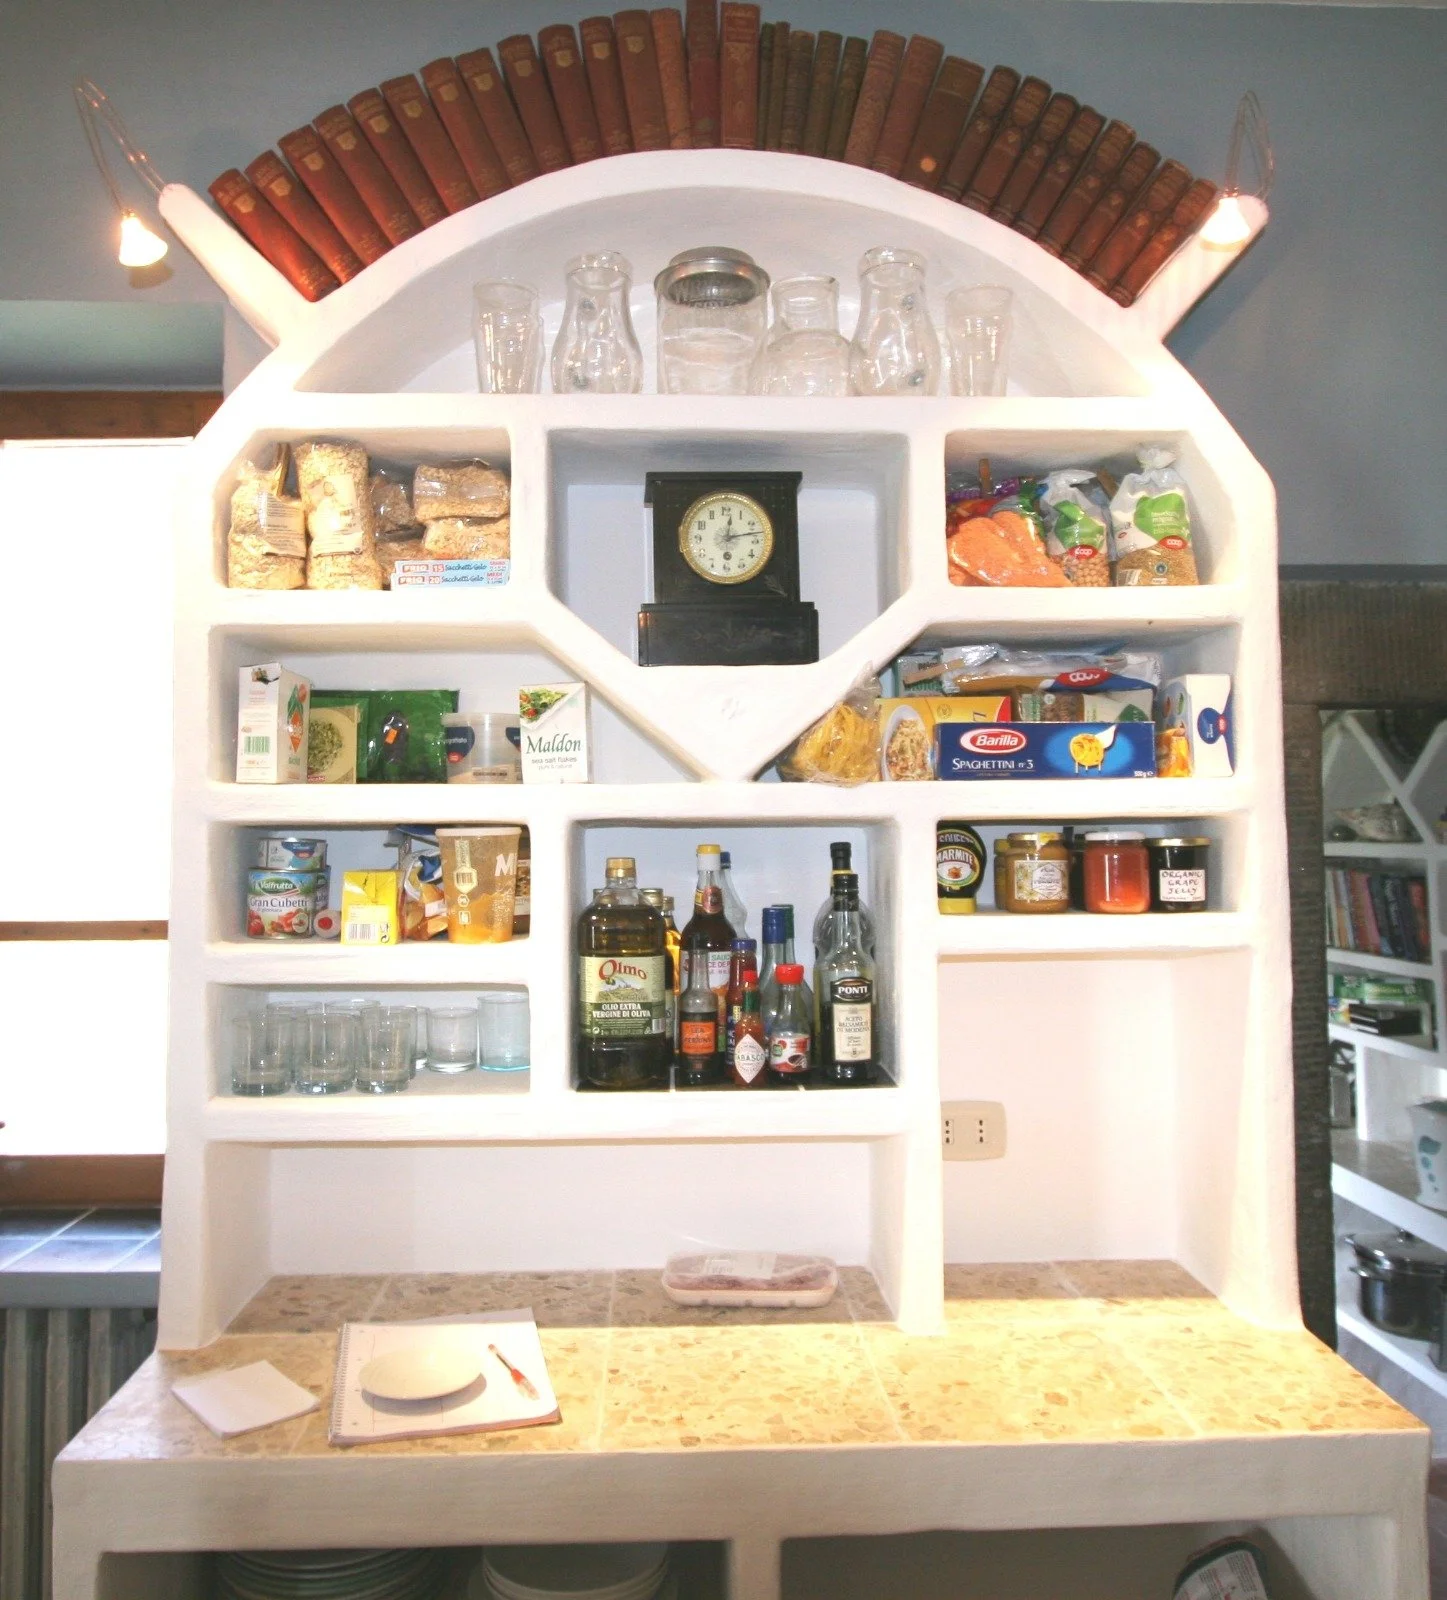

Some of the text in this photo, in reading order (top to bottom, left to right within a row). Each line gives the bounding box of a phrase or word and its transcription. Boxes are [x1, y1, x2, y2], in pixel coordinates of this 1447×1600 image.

[709, 510, 715, 520] 11
[721, 506, 732, 517] 12
[739, 510, 743, 520] 1
[697, 520, 706, 530] 10
[748, 520, 755, 531] 2
[694, 534, 702, 544] 9
[748, 549, 756, 559] 4
[708, 558, 715, 568] 7
[723, 562, 731, 572] 6
[737, 559, 746, 569] 5
[526, 733, 581, 754] Maldon
[976, 735, 1018, 746] Barilla
[952, 758, 1015, 770] SPAGHETTINI
[1026, 760, 1034, 769] 3
[1162, 871, 1203, 879] ORGANIC
[260, 881, 293, 890] Valfrutto
[1168, 879, 1199, 887] GRAPE
[1168, 887, 1198, 896] JELLY
[270, 897, 308, 907] Cubetti
[598, 959, 648, 981] Olmo
[837, 985, 868, 994] PONTI
[601, 1003, 618, 1011] OLIO
[592, 1010, 652, 1018] VERGINE DI OLIVA
